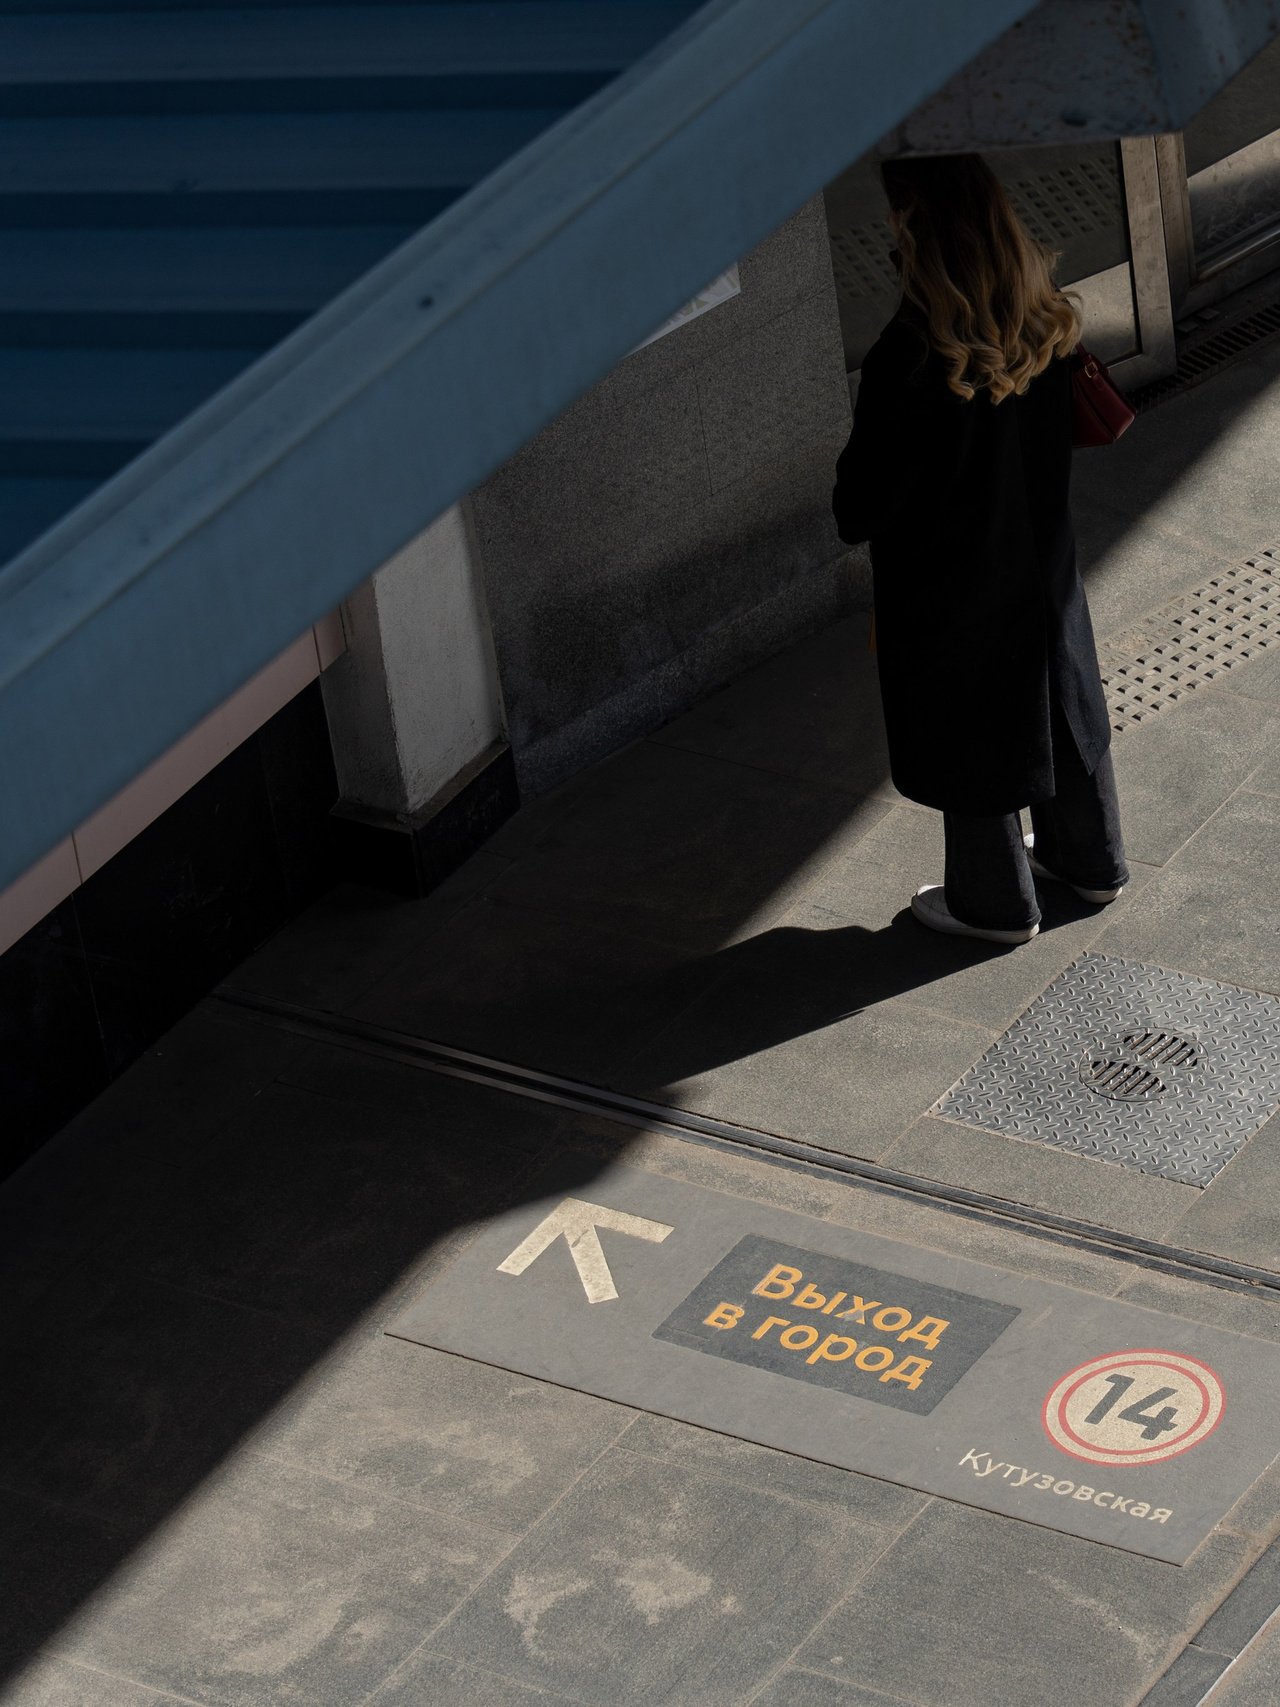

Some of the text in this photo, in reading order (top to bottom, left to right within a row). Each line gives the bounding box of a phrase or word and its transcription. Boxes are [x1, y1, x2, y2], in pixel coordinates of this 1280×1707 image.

[703, 1303, 933, 1390] в город
[752, 1264, 950, 1350] Выход
[1084, 1373, 1178, 1440] 14
[958, 1448, 1174, 1524] Кутузовская
